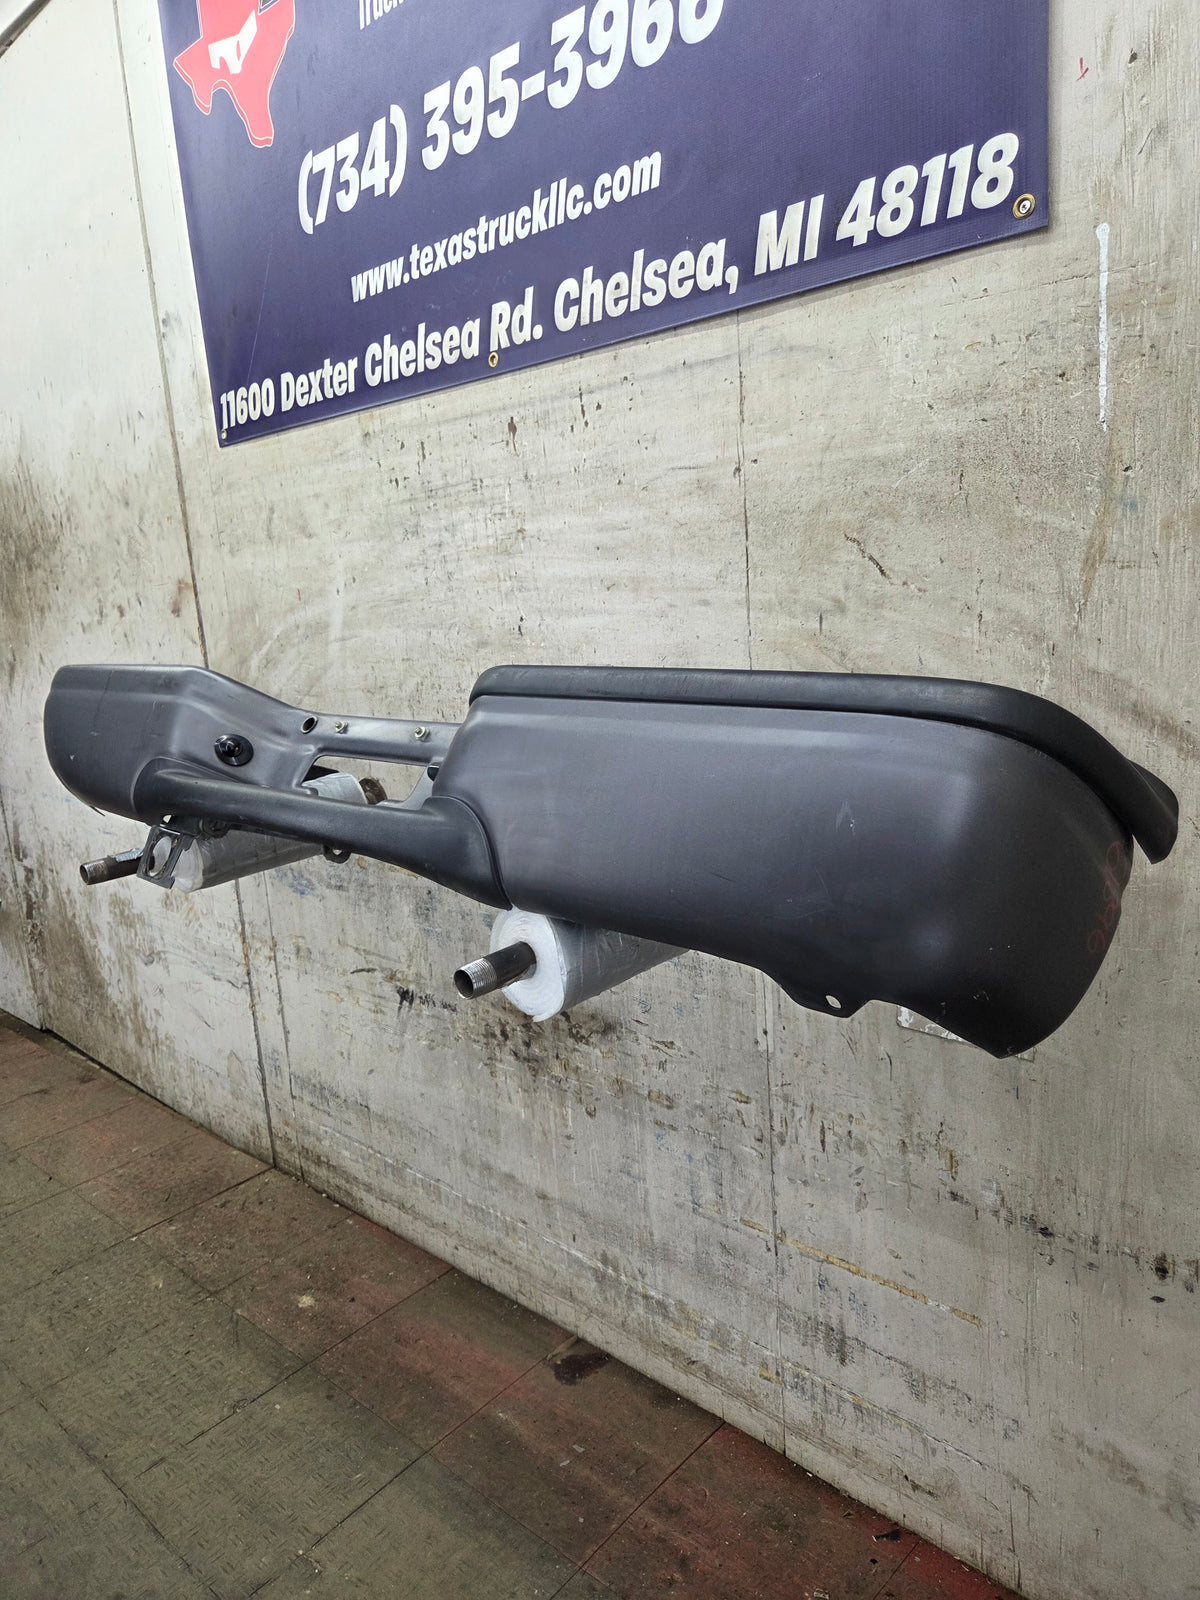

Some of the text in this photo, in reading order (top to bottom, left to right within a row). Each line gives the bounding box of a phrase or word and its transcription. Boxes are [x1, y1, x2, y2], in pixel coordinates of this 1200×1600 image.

[298, 104, 408, 234] (734)
[350, 151, 662, 302] www.texastruckllc.com
[220, 132, 1020, 431] 11600 Dexter Chelsea Rd. Chelsea, MI 48118
